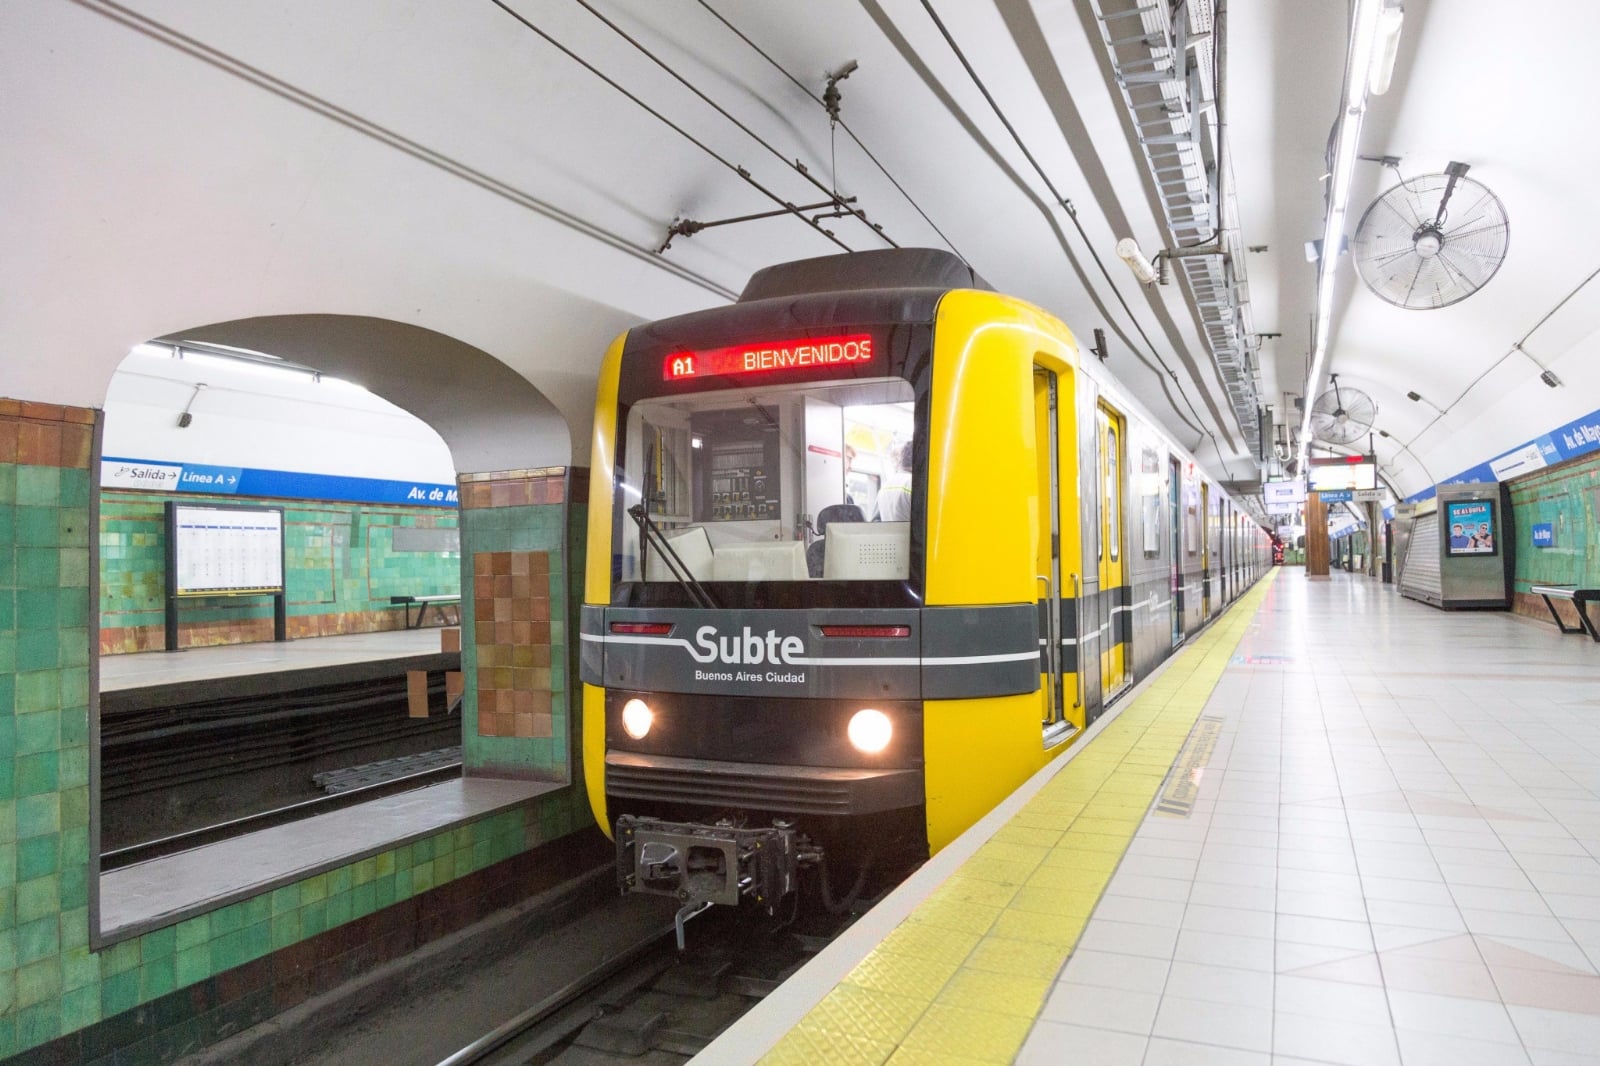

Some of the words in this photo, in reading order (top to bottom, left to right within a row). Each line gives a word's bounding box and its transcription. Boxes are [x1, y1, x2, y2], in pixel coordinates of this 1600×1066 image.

[743, 339, 872, 371] BIENVENIDOS
[672, 356, 695, 376] A1
[130, 467, 166, 480] Salida
[214, 474, 224, 484] A
[407, 486, 426, 500] Av.
[428, 487, 444, 501] de
[695, 625, 805, 666] Subte
[695, 670, 733, 681] Buenos
[735, 671, 763, 682] Aires
[765, 672, 805, 683] Ciudad
